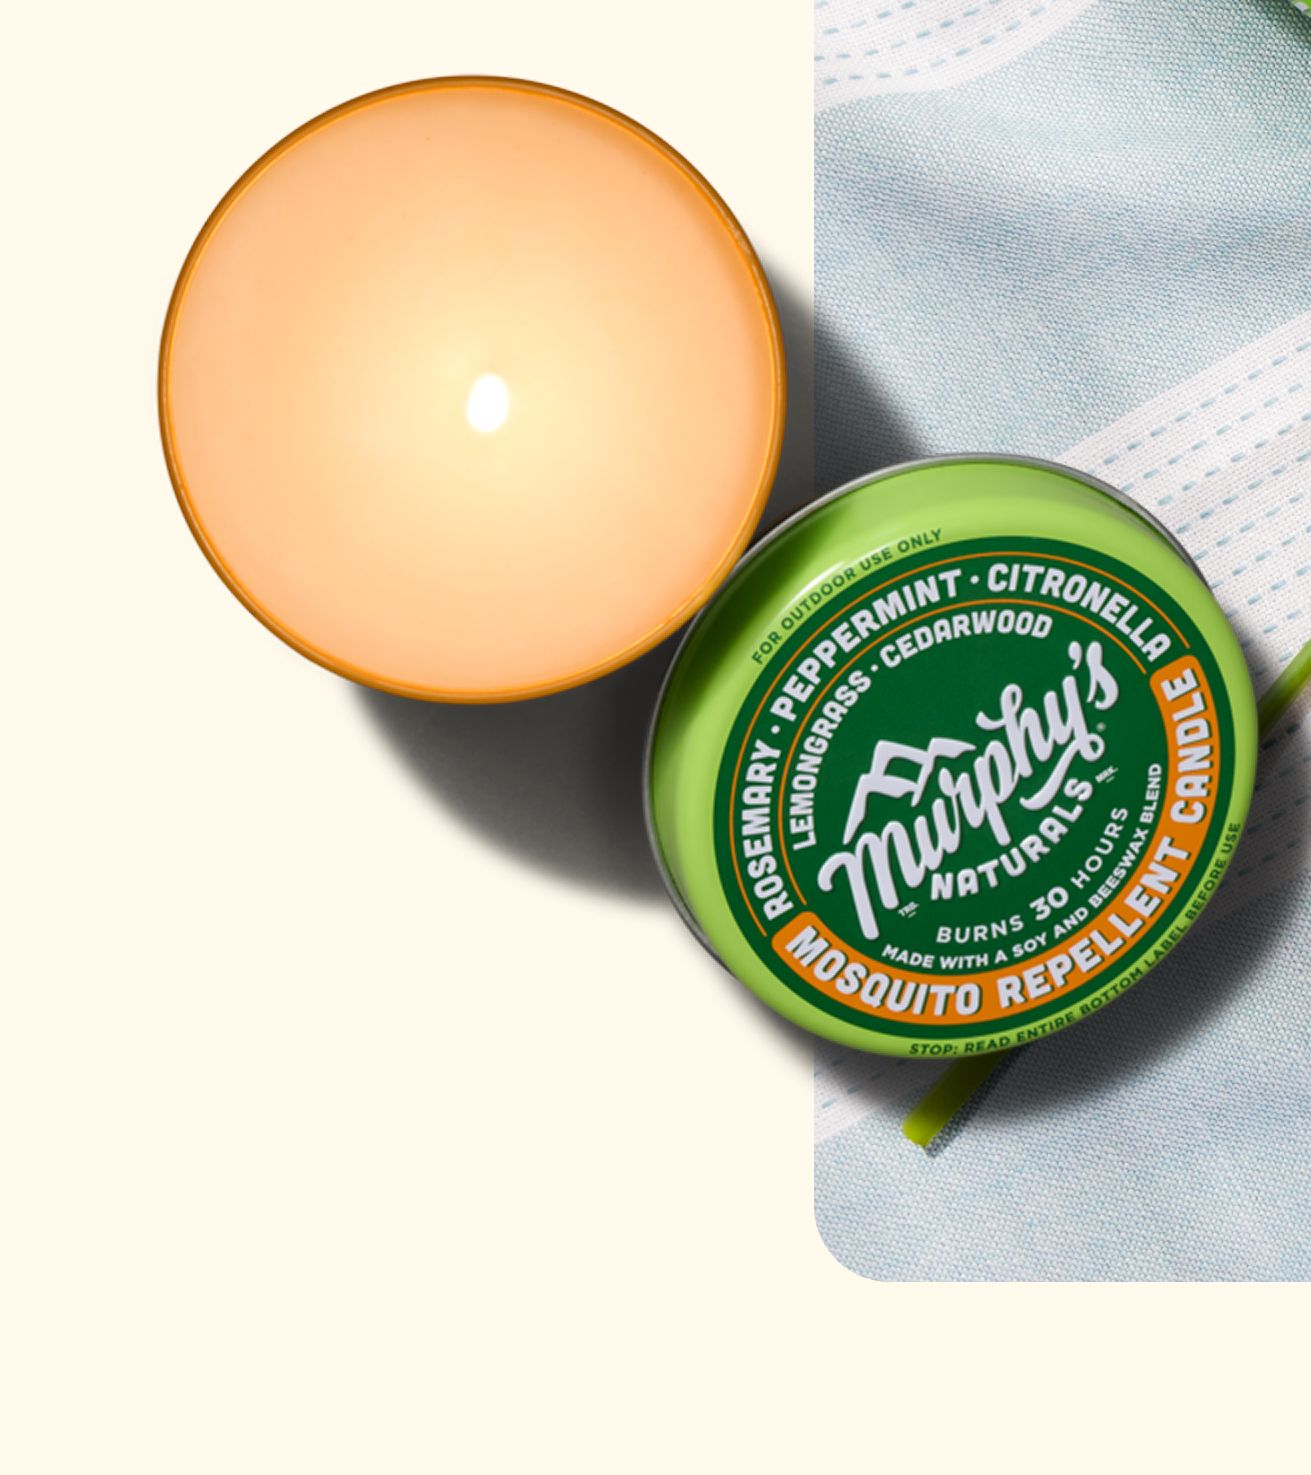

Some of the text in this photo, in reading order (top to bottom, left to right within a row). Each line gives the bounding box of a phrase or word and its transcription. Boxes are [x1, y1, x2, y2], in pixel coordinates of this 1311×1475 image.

[752, 528, 942, 664] FOR OUTDOOR USE ONLY
[742, 562, 1172, 921] ROSEMARY PEPPERMINT CITRONELLA
[785, 668, 1214, 1016] MOSQUITO REPELLENT CANDLE
[790, 609, 1053, 850] LEMONGRASS CEDARWOOD
[817, 641, 1119, 940] Murphy's
[931, 778, 1093, 900] NATURALS
[882, 763, 1162, 969] MADE WITH A SOY AND BEESWAX BLEND
[909, 822, 1241, 1056] STOP: READ ENTIRE BOTTOM LABEL BEFORE USE
[936, 807, 1128, 944] BURNS 30 HOURS
